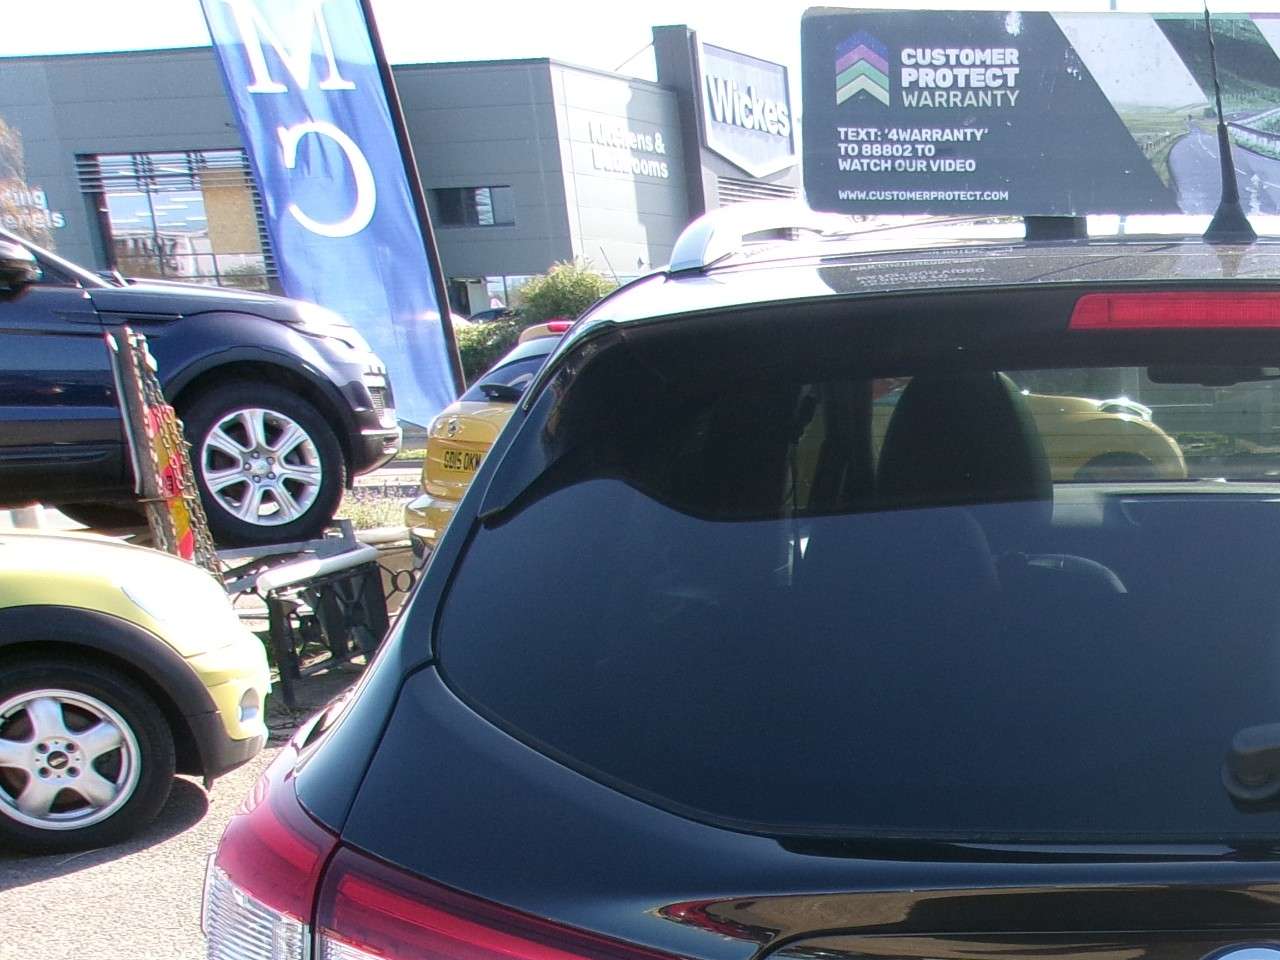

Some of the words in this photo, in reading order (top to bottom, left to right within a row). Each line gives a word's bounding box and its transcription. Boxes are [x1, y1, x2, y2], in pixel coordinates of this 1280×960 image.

[901, 48, 1020, 66] CUSTOMER
[901, 67, 1020, 88] PROTECT
[706, 74, 790, 137] Wickes
[902, 89, 1020, 108] WARRANTY
[654, 131, 666, 154] &
[837, 127, 882, 141] TEXT:
[837, 143, 859, 156] TO
[861, 144, 913, 157] 88802
[914, 144, 936, 157] TO
[837, 158, 892, 172] WATCH
[894, 159, 927, 172] OUR
[929, 159, 976, 172] VIDEO
[837, 190, 1009, 201] WWW.CUSTOMERPROTECT.COM
